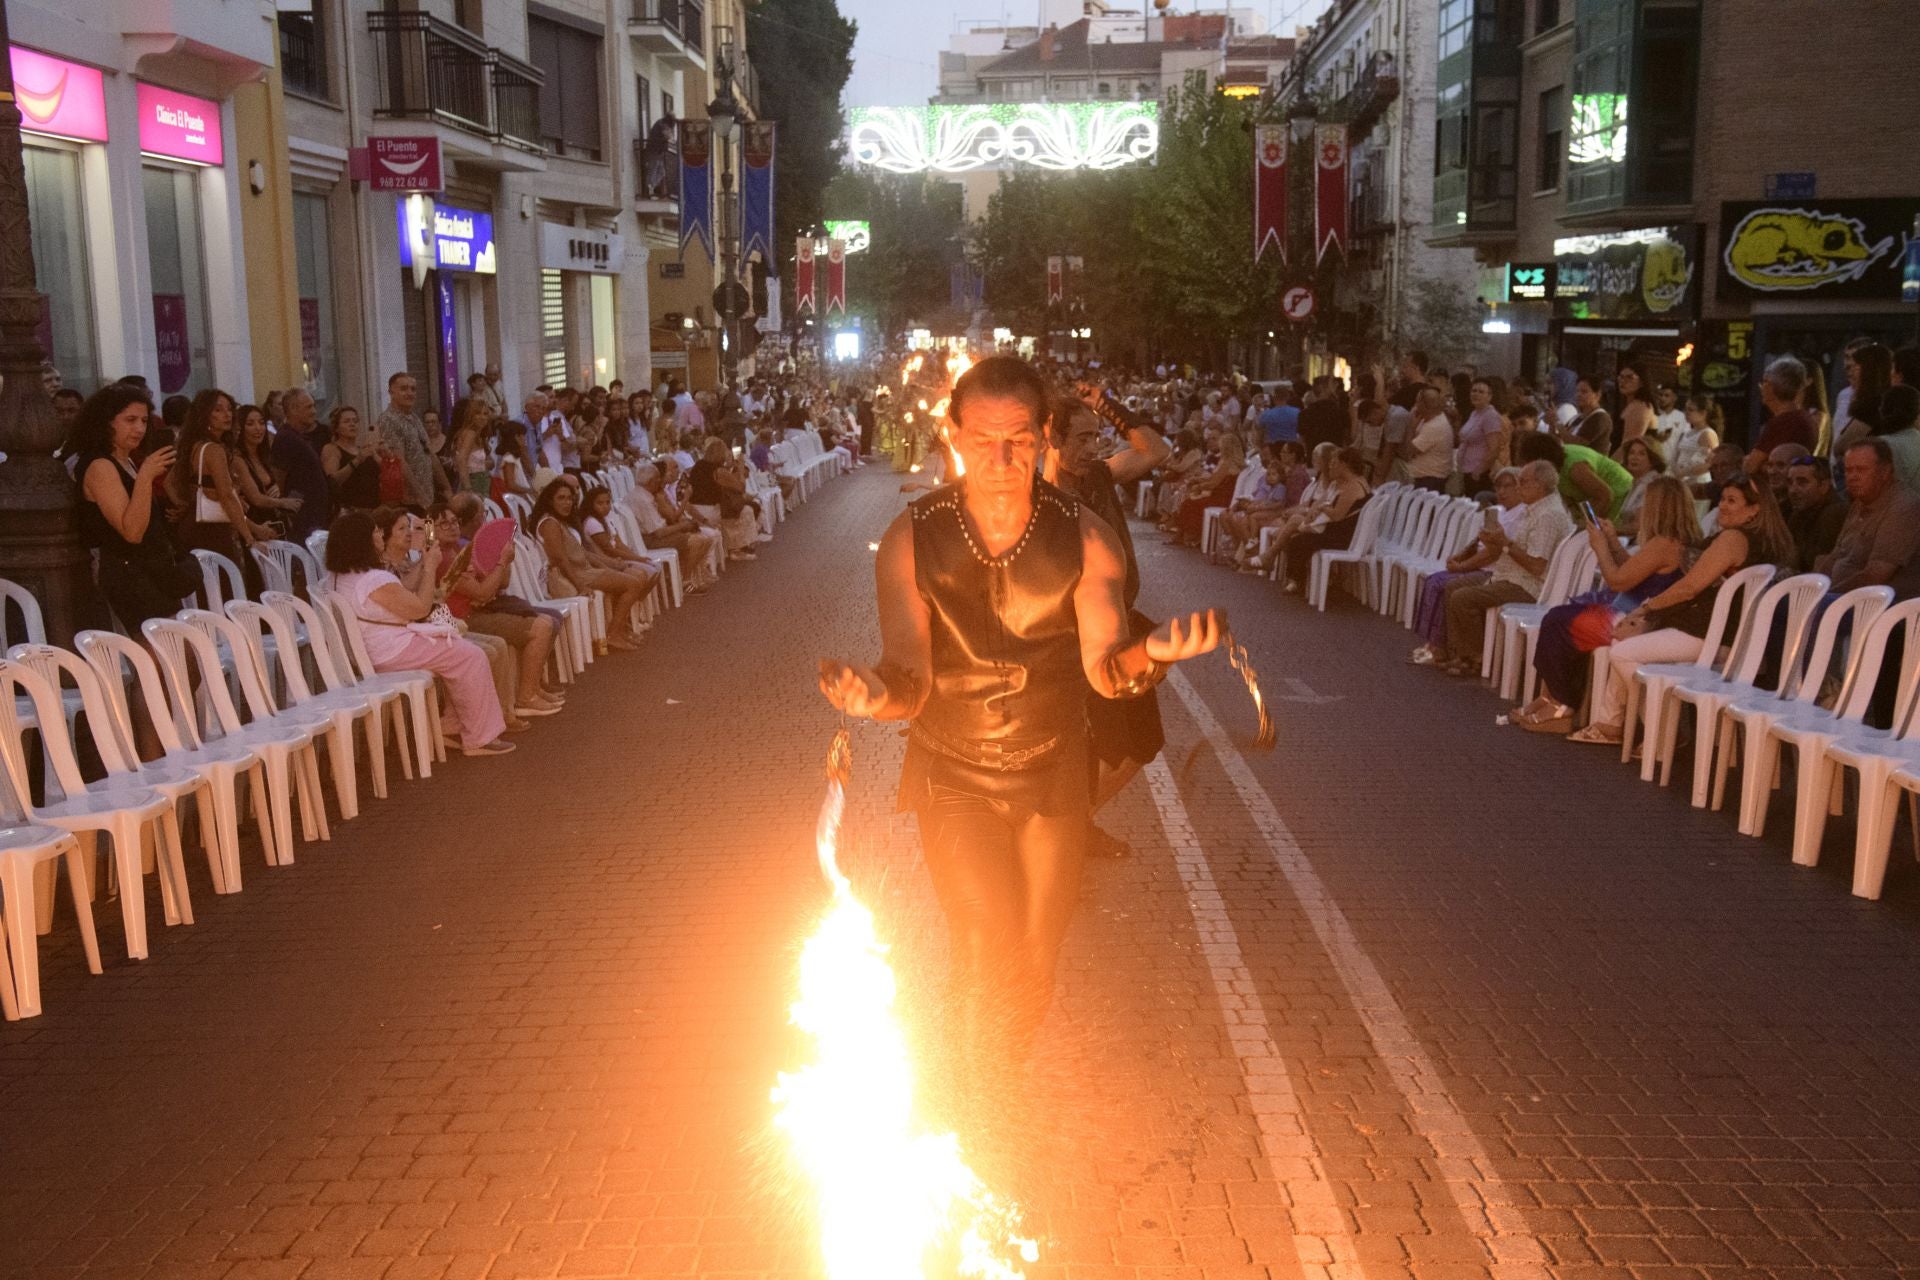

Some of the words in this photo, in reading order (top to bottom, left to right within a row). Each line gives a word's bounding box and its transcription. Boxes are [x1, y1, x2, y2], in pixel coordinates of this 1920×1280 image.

[177, 109, 185, 129] El
[184, 111, 205, 132] Puente
[377, 140, 386, 152] El
[387, 140, 418, 152] Puente
[380, 177, 394, 188] 968
[395, 177, 406, 188] 22
[407, 177, 417, 188] 62
[418, 177, 429, 188] 40
